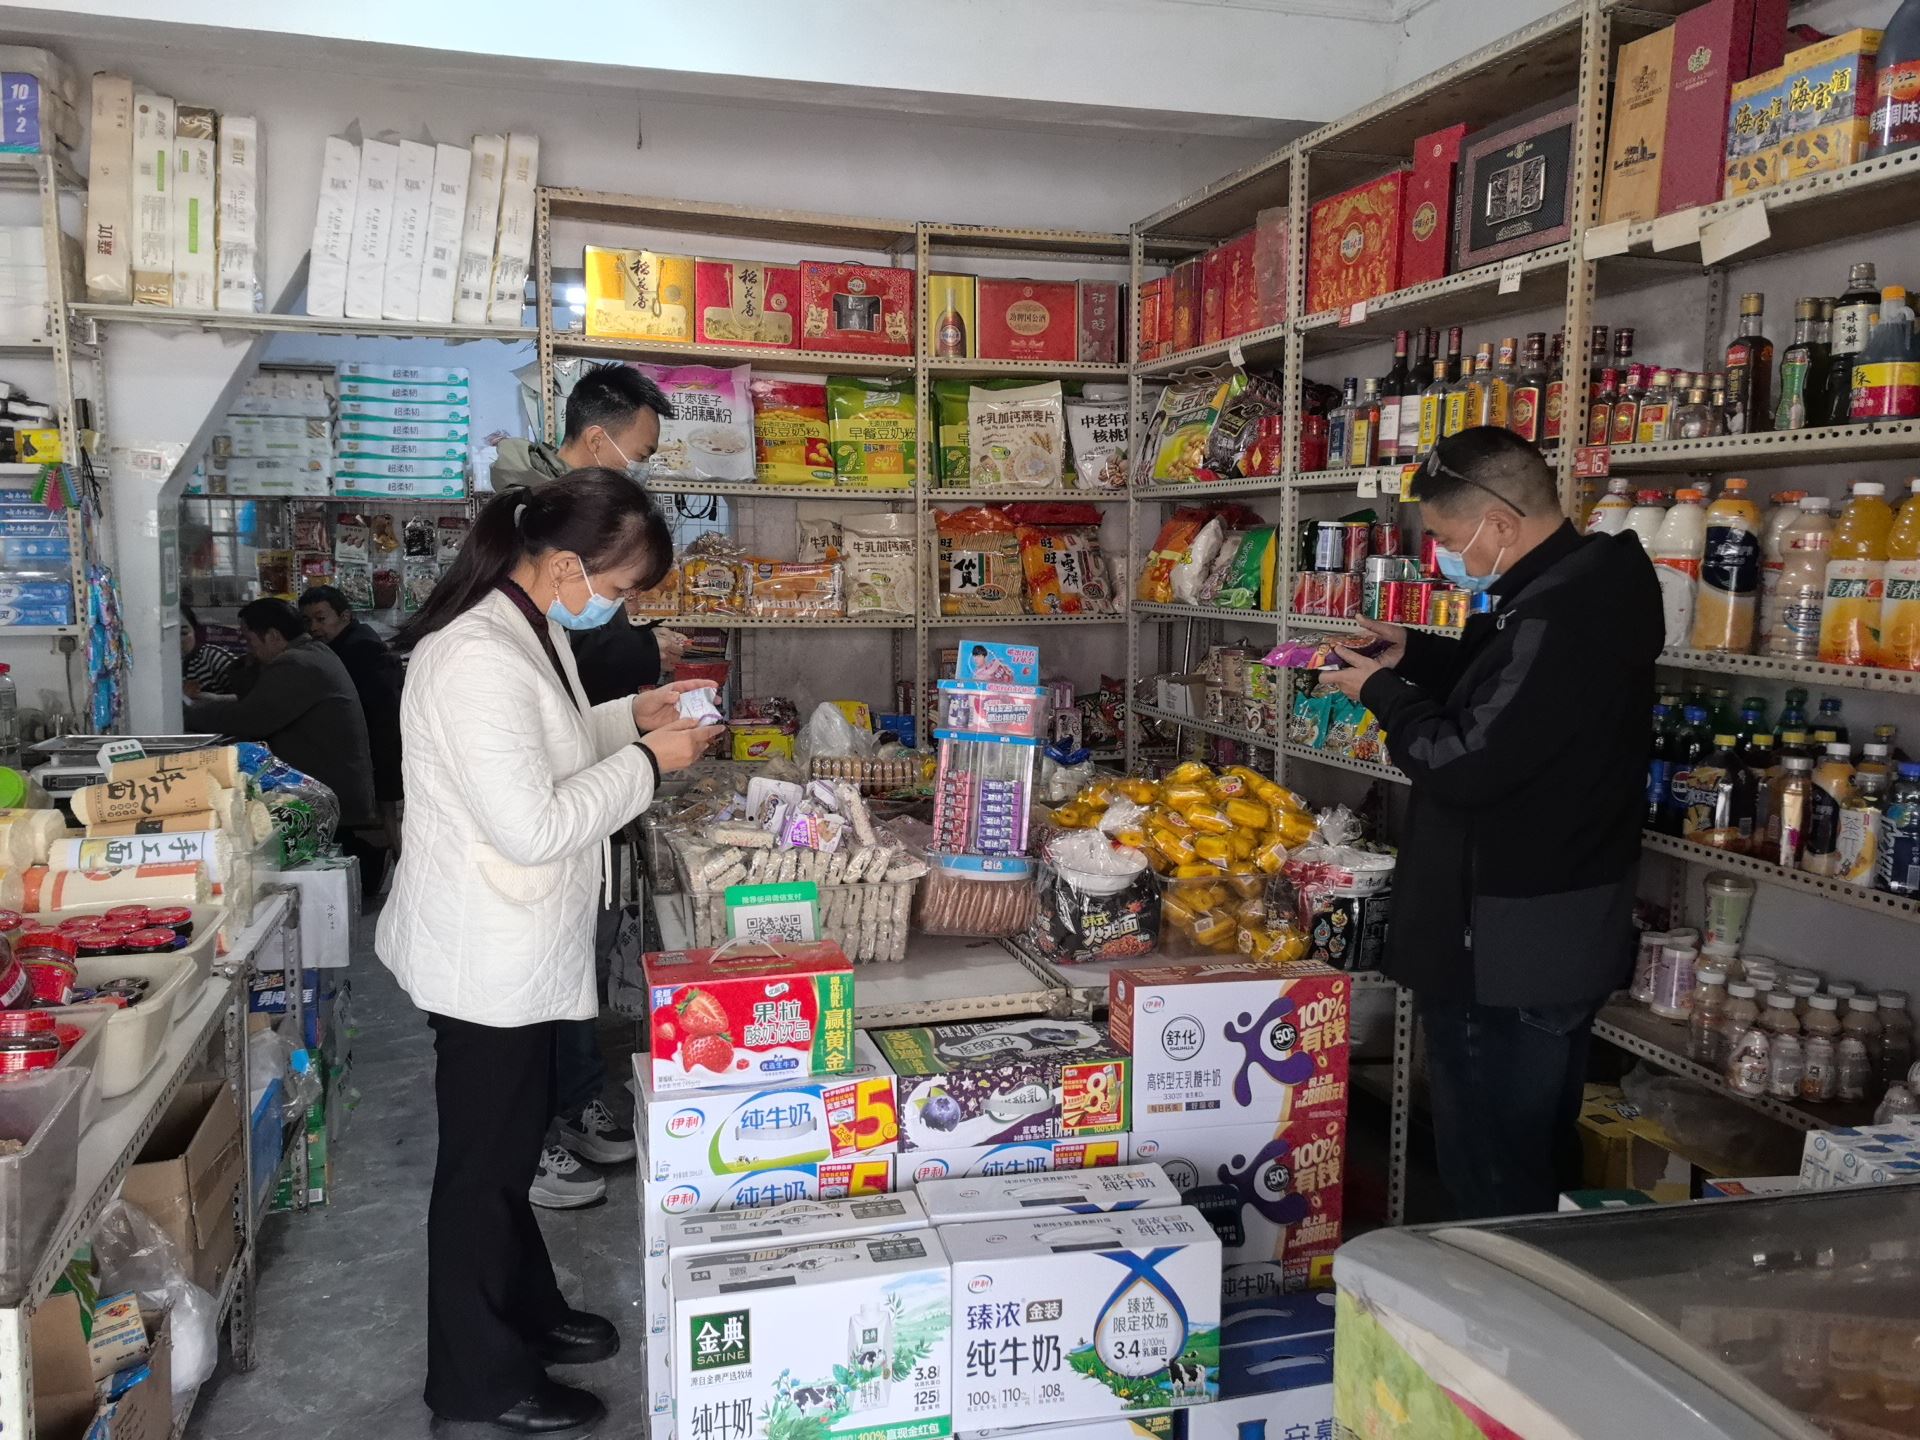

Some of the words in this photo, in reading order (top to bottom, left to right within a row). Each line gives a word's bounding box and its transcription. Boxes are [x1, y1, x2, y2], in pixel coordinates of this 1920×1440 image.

[10, 84, 29, 100] 10
[15, 117, 27, 133] 2
[629, 258, 652, 310] 稻花香
[737, 268, 758, 318] 稻花香
[671, 392, 722, 407] 红枣莲子
[976, 410, 1056, 425] 牛乳加钙燕麦片
[874, 456, 897, 467] SOY
[940, 538, 953, 563] 旺旺
[982, 860, 1003, 870] 益达
[753, 999, 801, 1025] 果粒
[1297, 994, 1347, 1030] 100%
[744, 1021, 811, 1047] 酸奶饮品
[825, 1009, 846, 1072] 赢黄金
[1166, 1029, 1197, 1046] 舒化
[1300, 1017, 1346, 1052] 有钱
[1147, 1068, 1222, 1091] 高钙型无乳糖牛奶
[1086, 1072, 1107, 1114] 8
[670, 1117, 699, 1130] 伊利
[741, 1103, 812, 1130] 纯牛奶
[857, 1077, 896, 1150] 5
[1291, 1135, 1341, 1166] 100%
[917, 1166, 944, 1180] 伊利
[1294, 1157, 1341, 1192] 有钱
[736, 1180, 807, 1208] 纯牛奶
[1103, 1179, 1156, 1191] 纯牛奶
[666, 1194, 694, 1208] 伊利
[1137, 1222, 1195, 1236] 纯牛奶
[971, 1280, 990, 1290] 伊利
[1027, 1302, 1060, 1321] 金装
[1127, 1296, 1156, 1314] 臻选
[967, 1301, 1021, 1331] 臻浓
[1113, 1313, 1169, 1334] 限定牧场
[695, 1316, 745, 1356] 金典
[697, 1351, 746, 1366] SATINE
[966, 1334, 1062, 1378] 纯牛奶
[1113, 1340, 1141, 1361] 3.4
[914, 1366, 937, 1381] 3.8
[913, 1390, 937, 1406] 125
[1002, 1387, 1021, 1403] 110
[1041, 1383, 1061, 1399] 108
[691, 1397, 753, 1440] 纯牛奶
